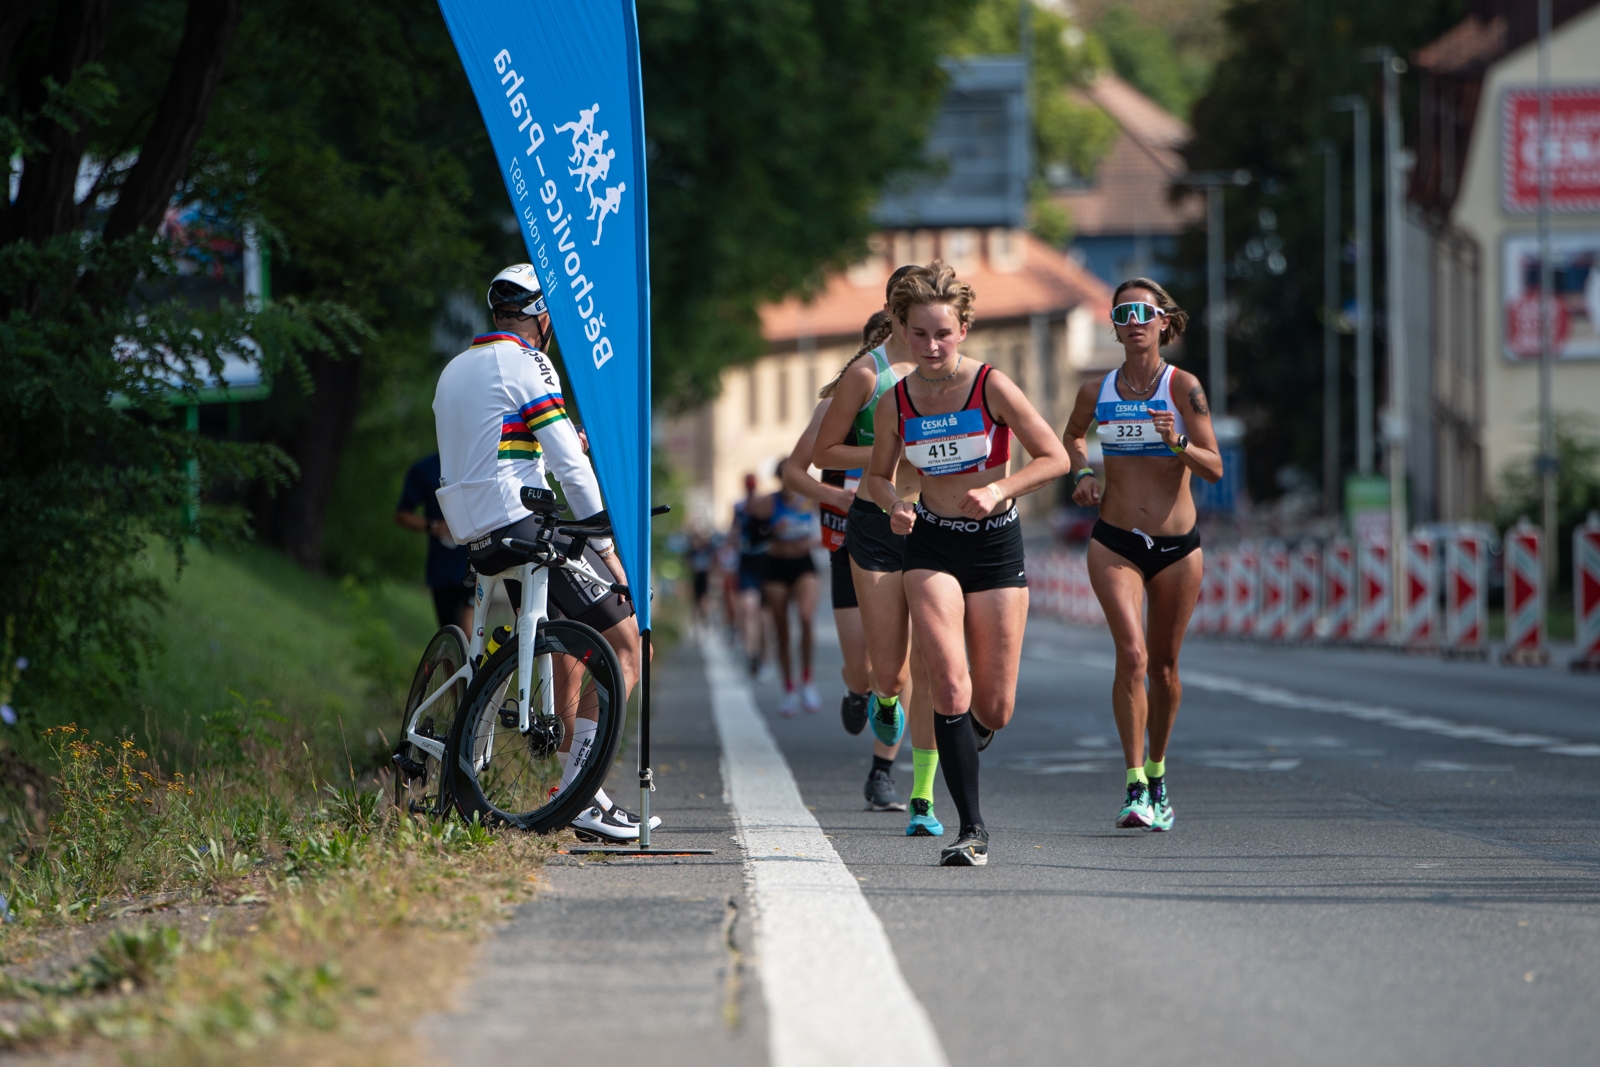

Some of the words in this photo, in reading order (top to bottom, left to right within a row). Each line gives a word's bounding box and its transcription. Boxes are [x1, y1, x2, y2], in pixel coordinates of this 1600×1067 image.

[1115, 404, 1138, 412] ČESKÁ
[921, 417, 948, 430] ČESKÁ
[1117, 425, 1142, 438] 323
[928, 442, 958, 458] 415
[528, 488, 543, 499] FLU
[939, 520, 980, 533] PRO
